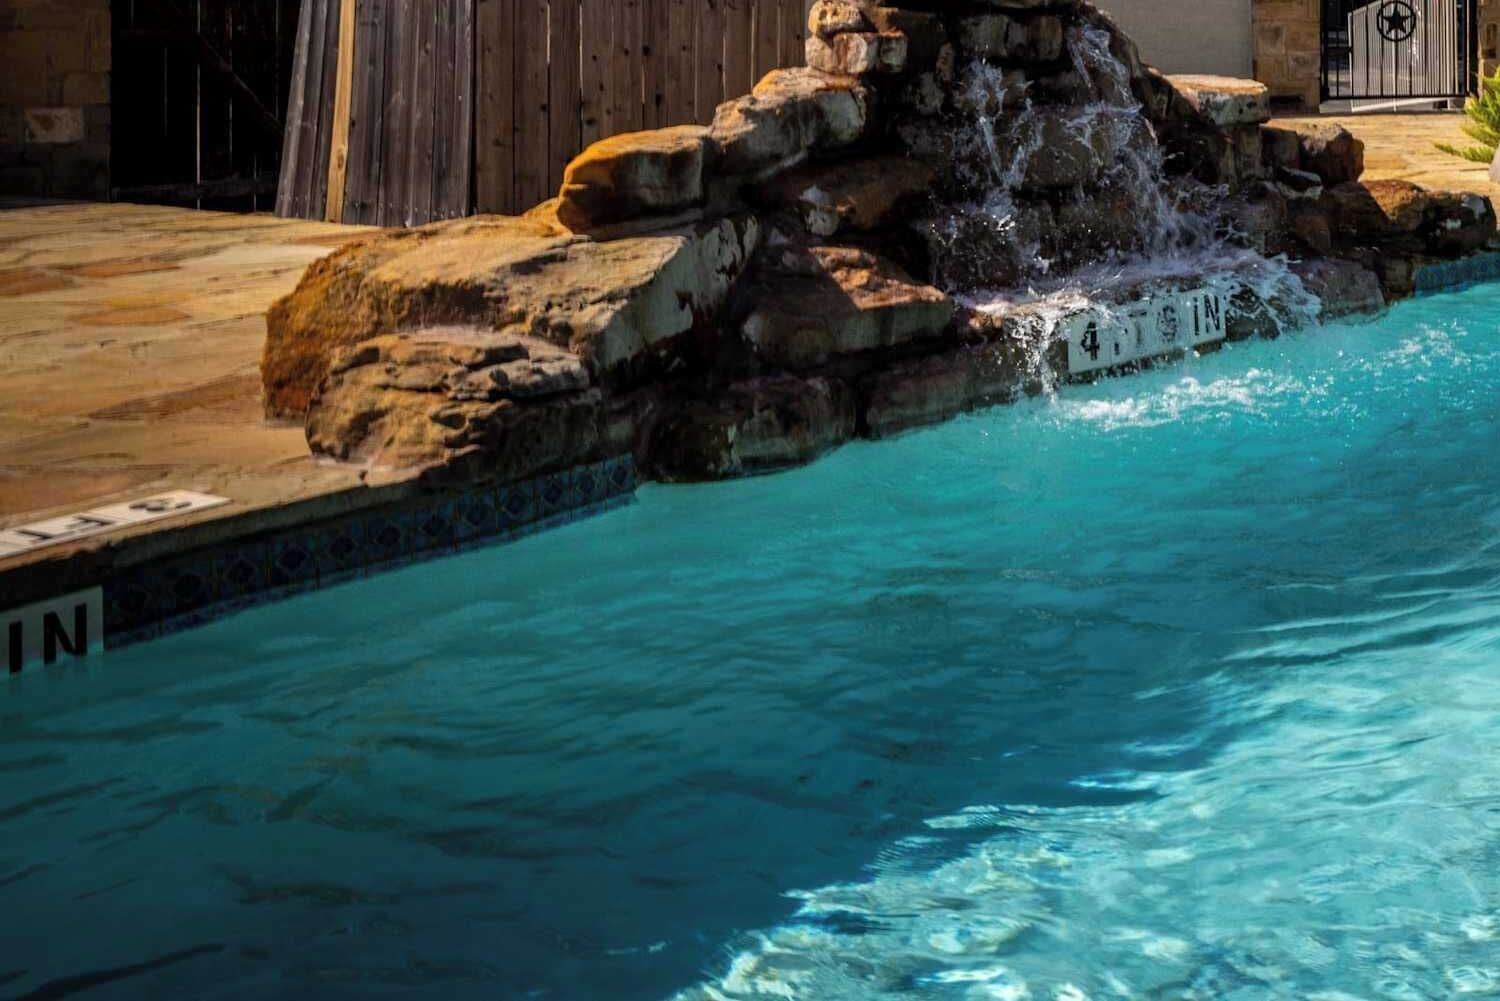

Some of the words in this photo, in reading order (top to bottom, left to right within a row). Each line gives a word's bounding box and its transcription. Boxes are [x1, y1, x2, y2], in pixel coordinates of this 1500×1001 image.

[1080, 321, 1100, 361] 4
[1194, 294, 1220, 337] IN
[9, 602, 88, 676] IN
